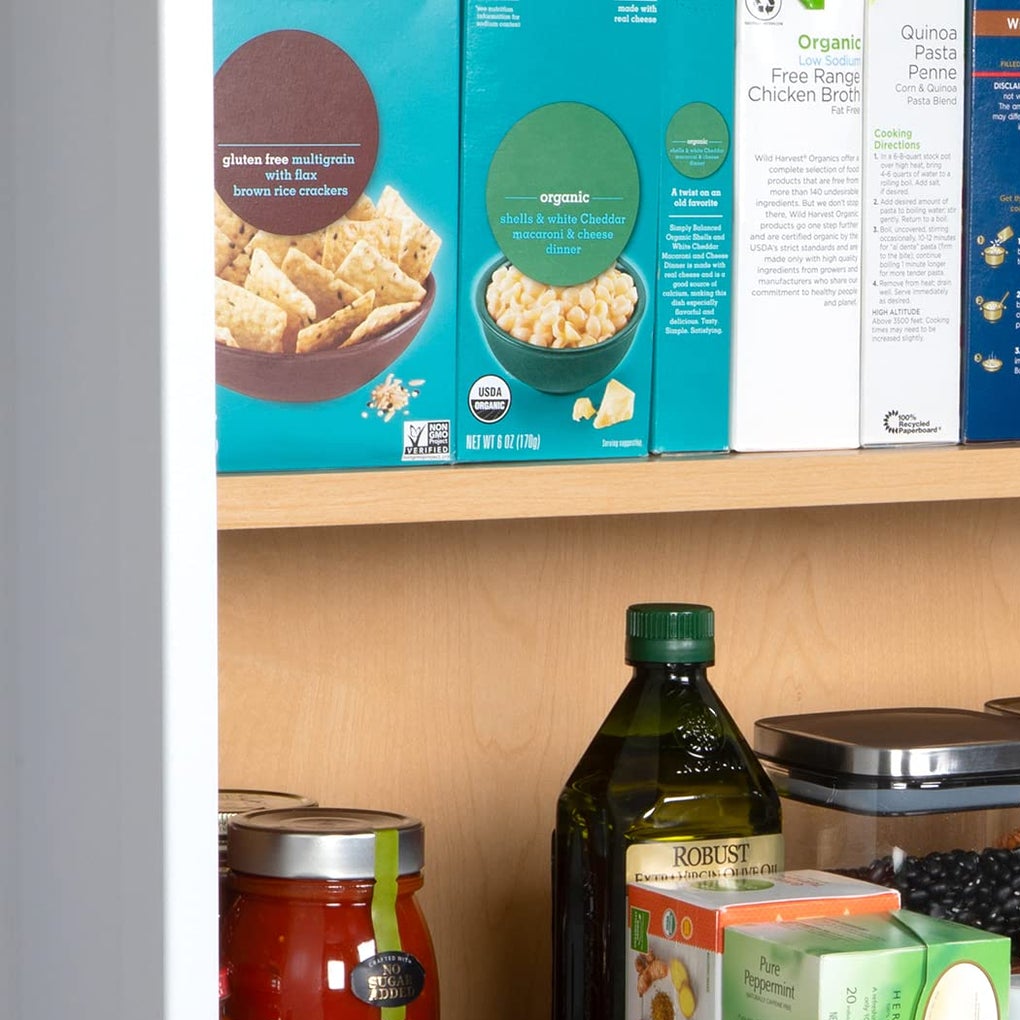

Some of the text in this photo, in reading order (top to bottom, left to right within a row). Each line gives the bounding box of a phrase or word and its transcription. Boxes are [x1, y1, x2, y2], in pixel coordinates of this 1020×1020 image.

[617, 4, 658, 13] made with
[614, 15, 658, 23] real cheese
[901, 24, 957, 41] Quinoa
[798, 34, 861, 53] Organic
[916, 45, 957, 60] Pasta
[799, 55, 861, 66] Low Sodium
[1000, 61, 1020, 69] FILLED
[772, 68, 861, 86] Free Range
[909, 65, 957, 80] Penne
[748, 85, 861, 102] Chicken Broth
[895, 83, 957, 94] Corn & Quinoa
[908, 96, 957, 106] Pasta Blend
[831, 106, 860, 115] Fat Free
[874, 128, 912, 140] Cooking
[874, 140, 920, 151] Directions
[223, 153, 354, 168] gluten free multigrain
[266, 168, 318, 181] with flax
[233, 184, 348, 197] brown rice crackers
[671, 188, 721, 197] A twist on an
[540, 191, 590, 206] organic
[674, 198, 718, 207] old favorite
[499, 212, 626, 225] shells & white Cheddar
[512, 228, 614, 240] macaroni & cheese
[666, 234, 725, 242] Organic Shells and
[545, 244, 583, 256] dinner
[672, 242, 719, 250] White Cheddar
[662, 252, 728, 260] Macaroni and Cheese
[890, 308, 920, 316] ALTITUDE
[478, 387, 502, 398] USDA
[474, 401, 505, 411] ORGANIC
[429, 423, 448, 431] NON
[898, 420, 930, 428] Recycled
[429, 430, 448, 438] GMO
[429, 438, 448, 446] Project
[466, 433, 541, 451] NET WT 6 OZ (170g)
[406, 446, 448, 454] VERIFIED
[673, 844, 750, 867] ROBUST
[368, 955, 396, 968] CRAFTED
[760, 956, 780, 977] Pure
[382, 964, 400, 976] NO
[368, 976, 412, 988] SUGAR
[744, 969, 795, 1000] Peppermint
[368, 987, 415, 1001] ADDED
[846, 987, 857, 1004] 20
